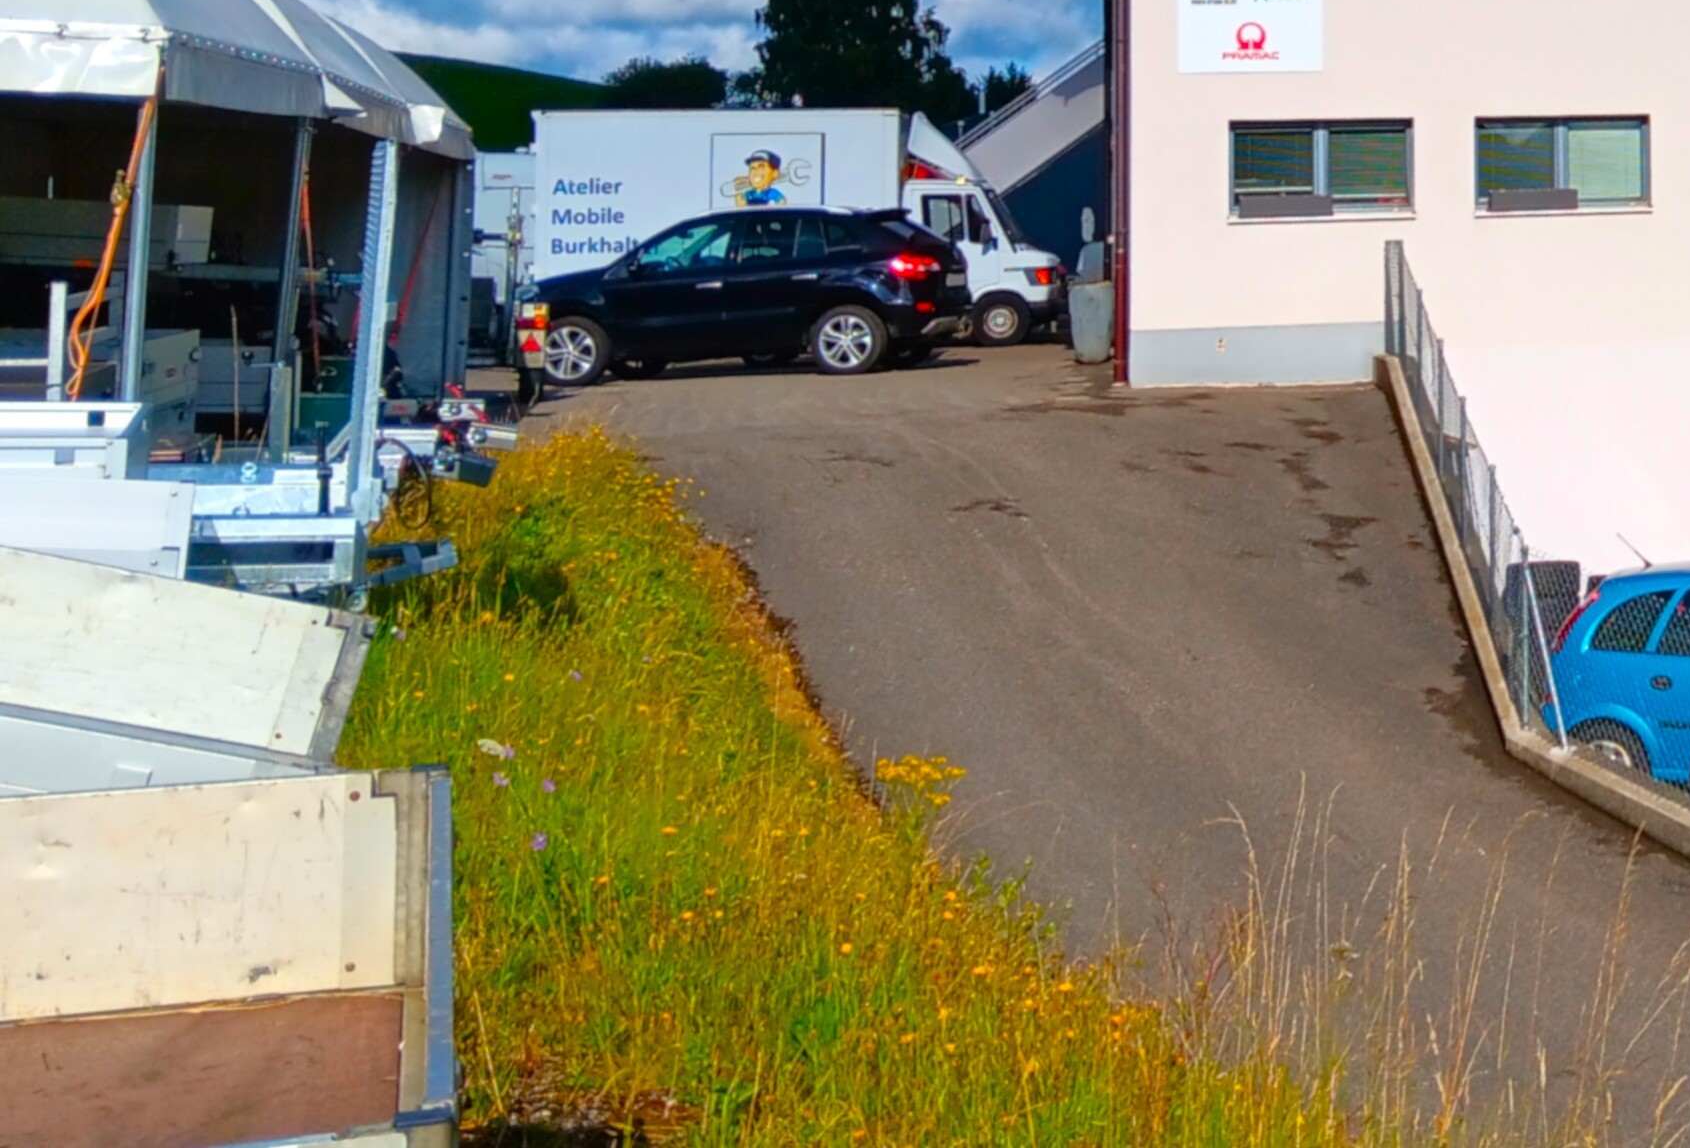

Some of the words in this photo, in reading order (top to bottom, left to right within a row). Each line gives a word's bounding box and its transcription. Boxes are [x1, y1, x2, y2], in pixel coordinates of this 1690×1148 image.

[1222, 51, 1280, 61] PRAMAC
[552, 177, 623, 195] Atelier
[551, 207, 625, 225] Mobile
